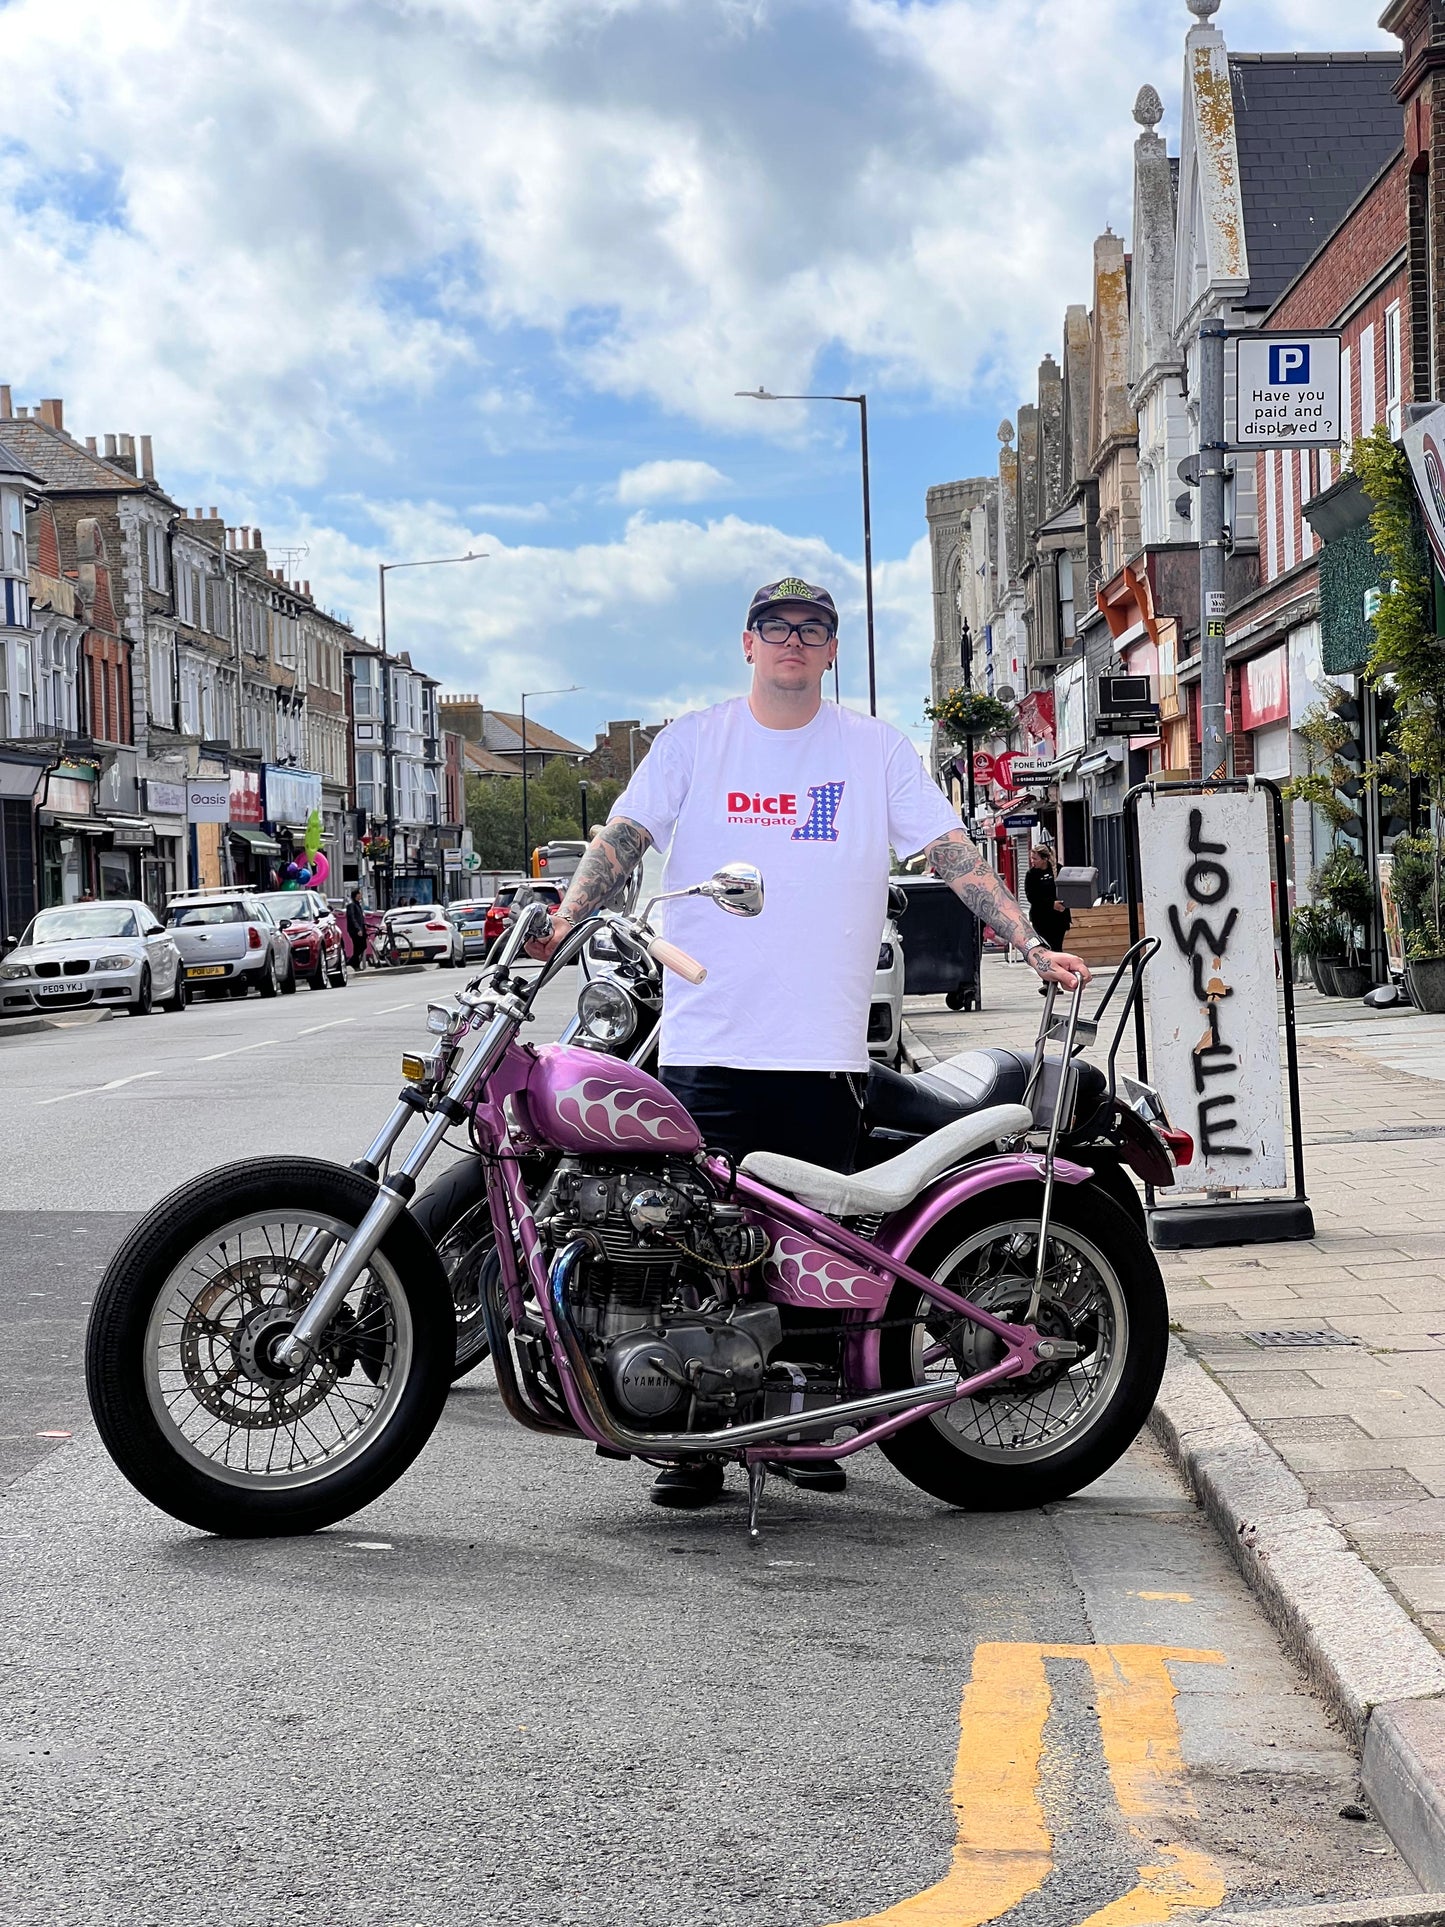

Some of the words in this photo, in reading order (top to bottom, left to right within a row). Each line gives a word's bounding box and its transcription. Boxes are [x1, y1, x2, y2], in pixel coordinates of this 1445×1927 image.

[1279, 348, 1303, 382] P
[1252, 390, 1290, 402] Have
[1298, 391, 1325, 403] you
[1255, 405, 1287, 420] paid
[1294, 404, 1322, 417] and
[1323, 420, 1333, 432] ?
[768, 585, 813, 600] STRINGS
[1013, 761, 1035, 769] FONE
[190, 793, 226, 805] Oasis
[790, 781, 845, 841] 1
[727, 816, 797, 827] margate
[42, 984, 65, 993] PE09
[65, 982, 83, 991] YKJ
[634, 1376, 675, 1386] YAMAHA
